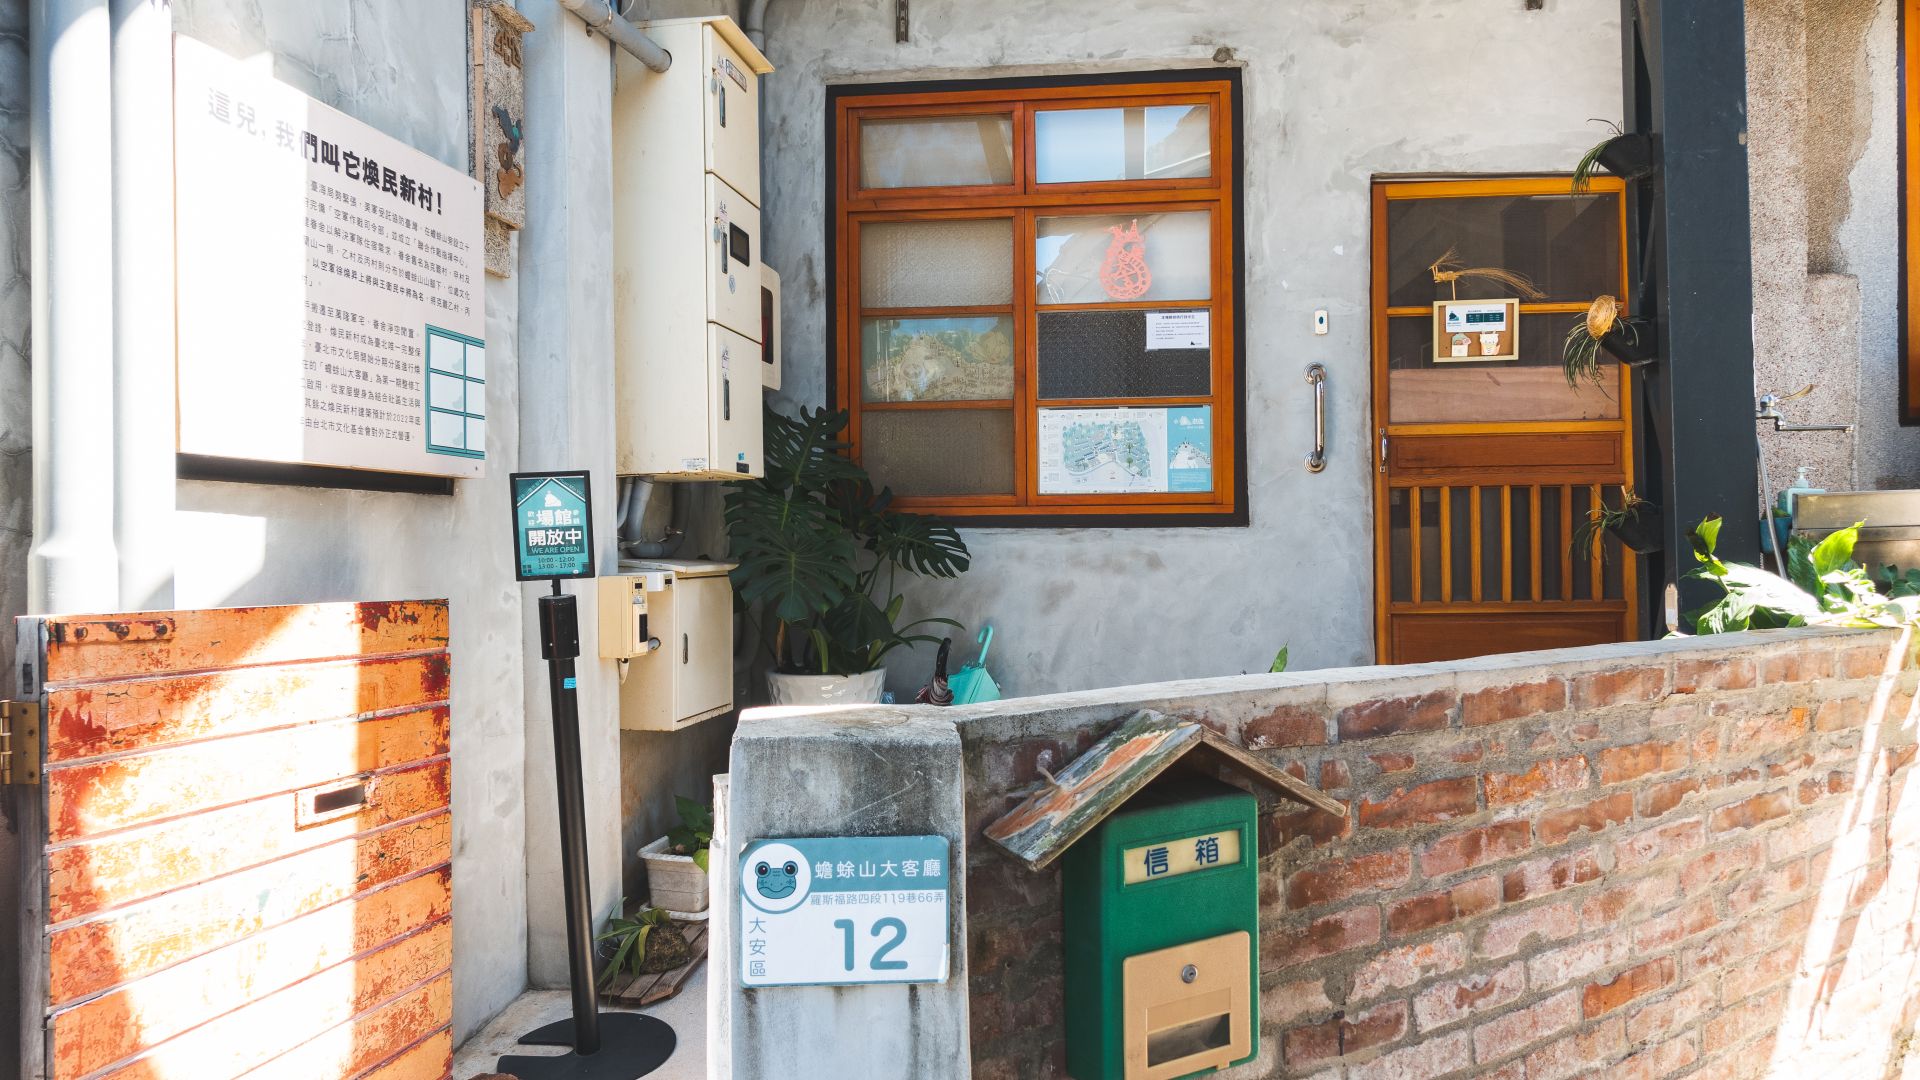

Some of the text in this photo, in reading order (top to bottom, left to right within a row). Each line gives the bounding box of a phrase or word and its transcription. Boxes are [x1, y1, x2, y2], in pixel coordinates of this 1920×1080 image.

[536, 509, 572, 526] 場館
[528, 528, 582, 547] 開放中
[1144, 836, 1219, 877] 信箱
[814, 859, 941, 879] 蟾蜍山大客廳
[810, 891, 945, 906] 羅斯福路四段119巷66弄
[748, 917, 767, 977] 大安區
[833, 916, 909, 972] 12
